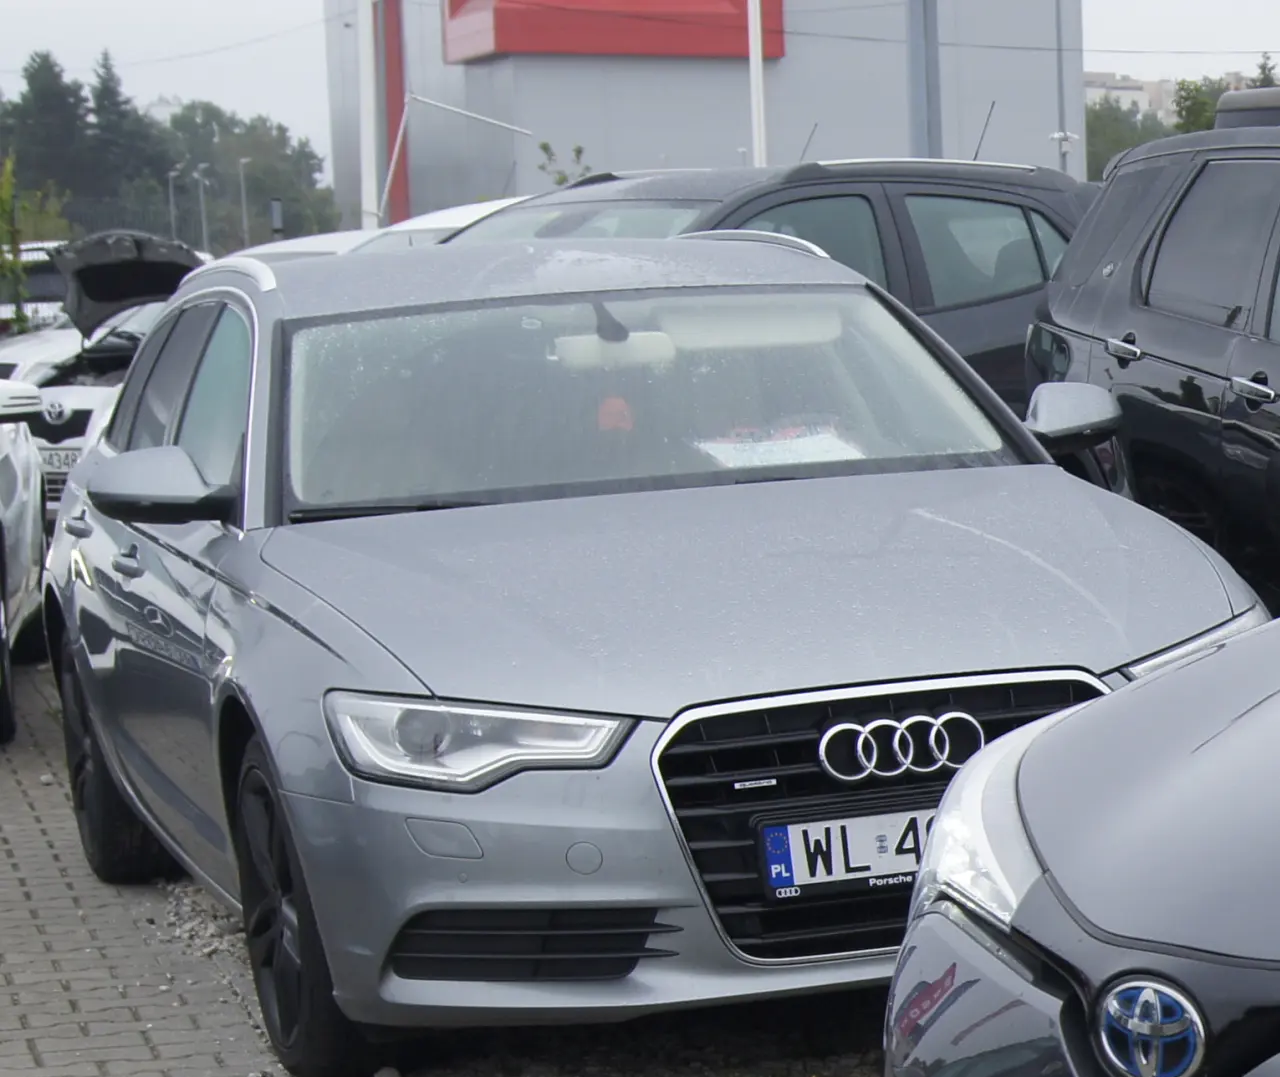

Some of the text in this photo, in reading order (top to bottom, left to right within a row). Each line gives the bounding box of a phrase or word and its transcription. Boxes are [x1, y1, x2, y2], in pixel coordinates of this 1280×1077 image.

[801, 824, 872, 878] WL
[770, 864, 791, 879] PL
[868, 874, 913, 887] Porsche
